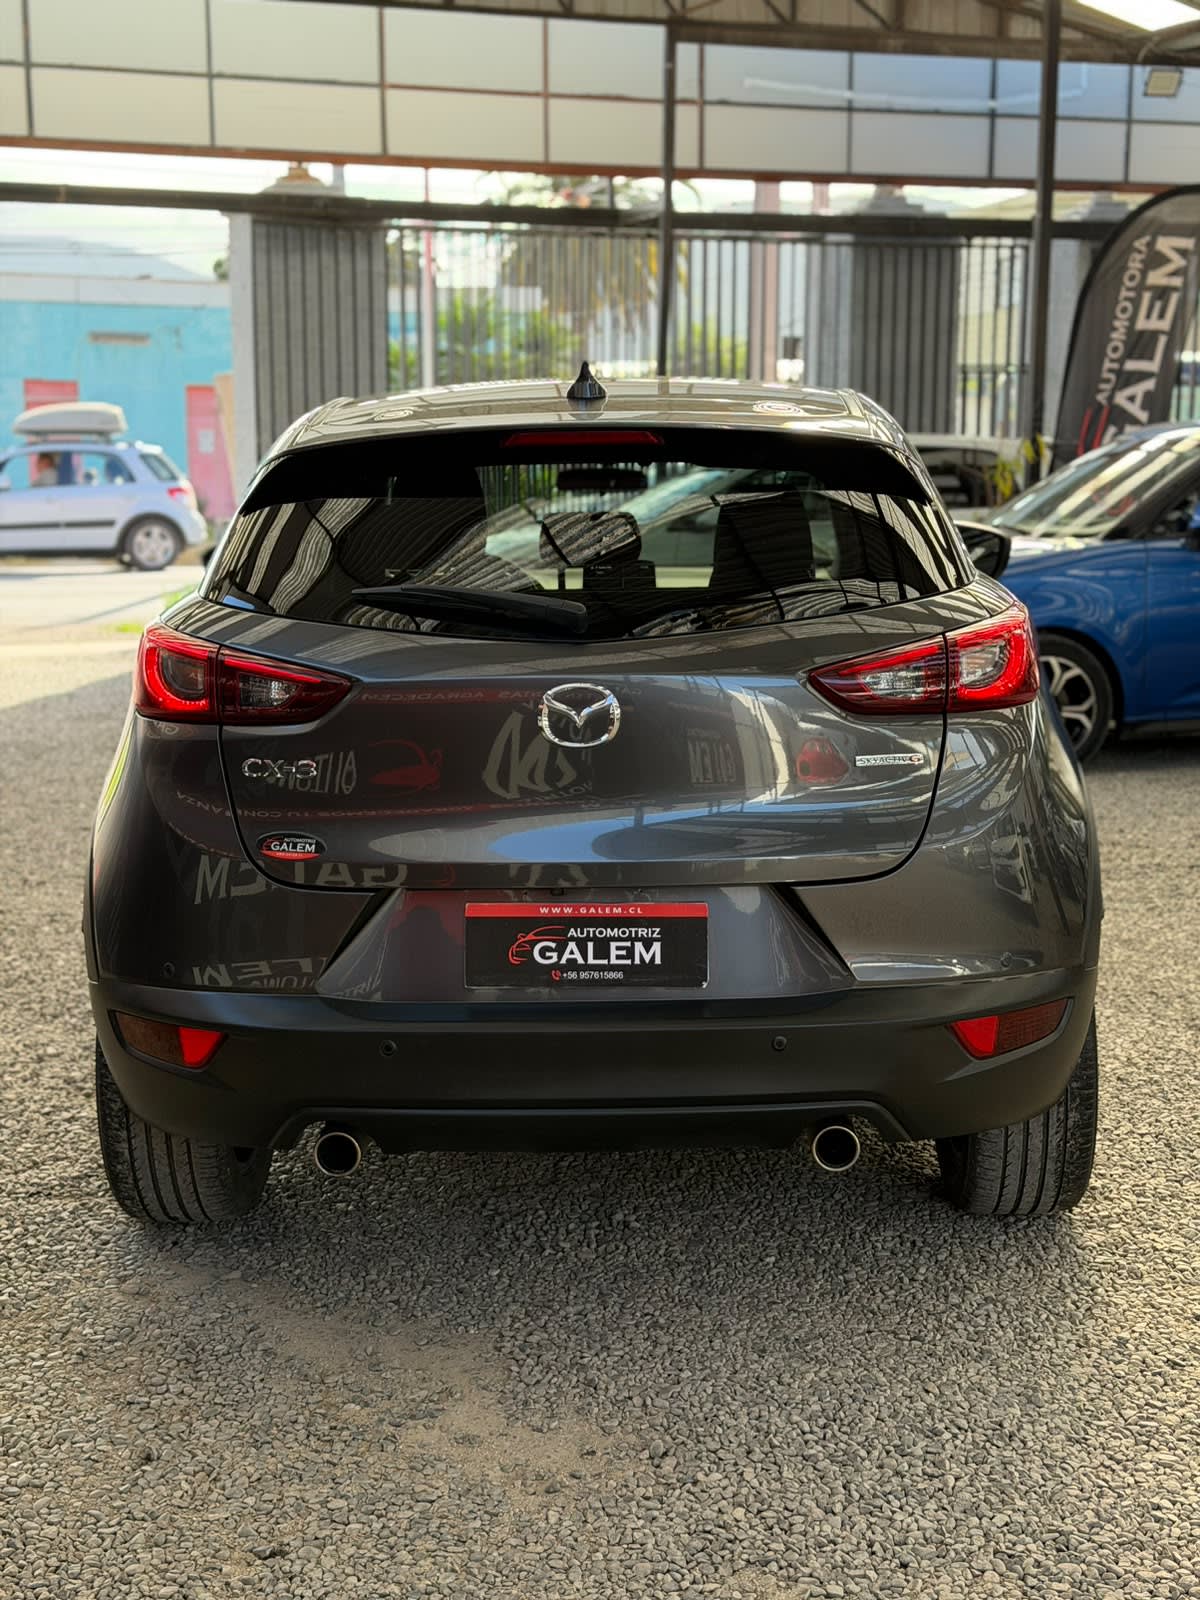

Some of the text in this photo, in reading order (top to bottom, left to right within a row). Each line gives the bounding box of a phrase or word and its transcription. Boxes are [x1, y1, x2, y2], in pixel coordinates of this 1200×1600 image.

[1096, 235, 1152, 407] AUTOMOTORA
[241, 758, 317, 778] CX-3
[271, 841, 316, 853] GALEM
[567, 927, 661, 938] AUTOMOTRIZ
[533, 941, 662, 965] GALEM
[563, 971, 624, 979] +56 957615866
